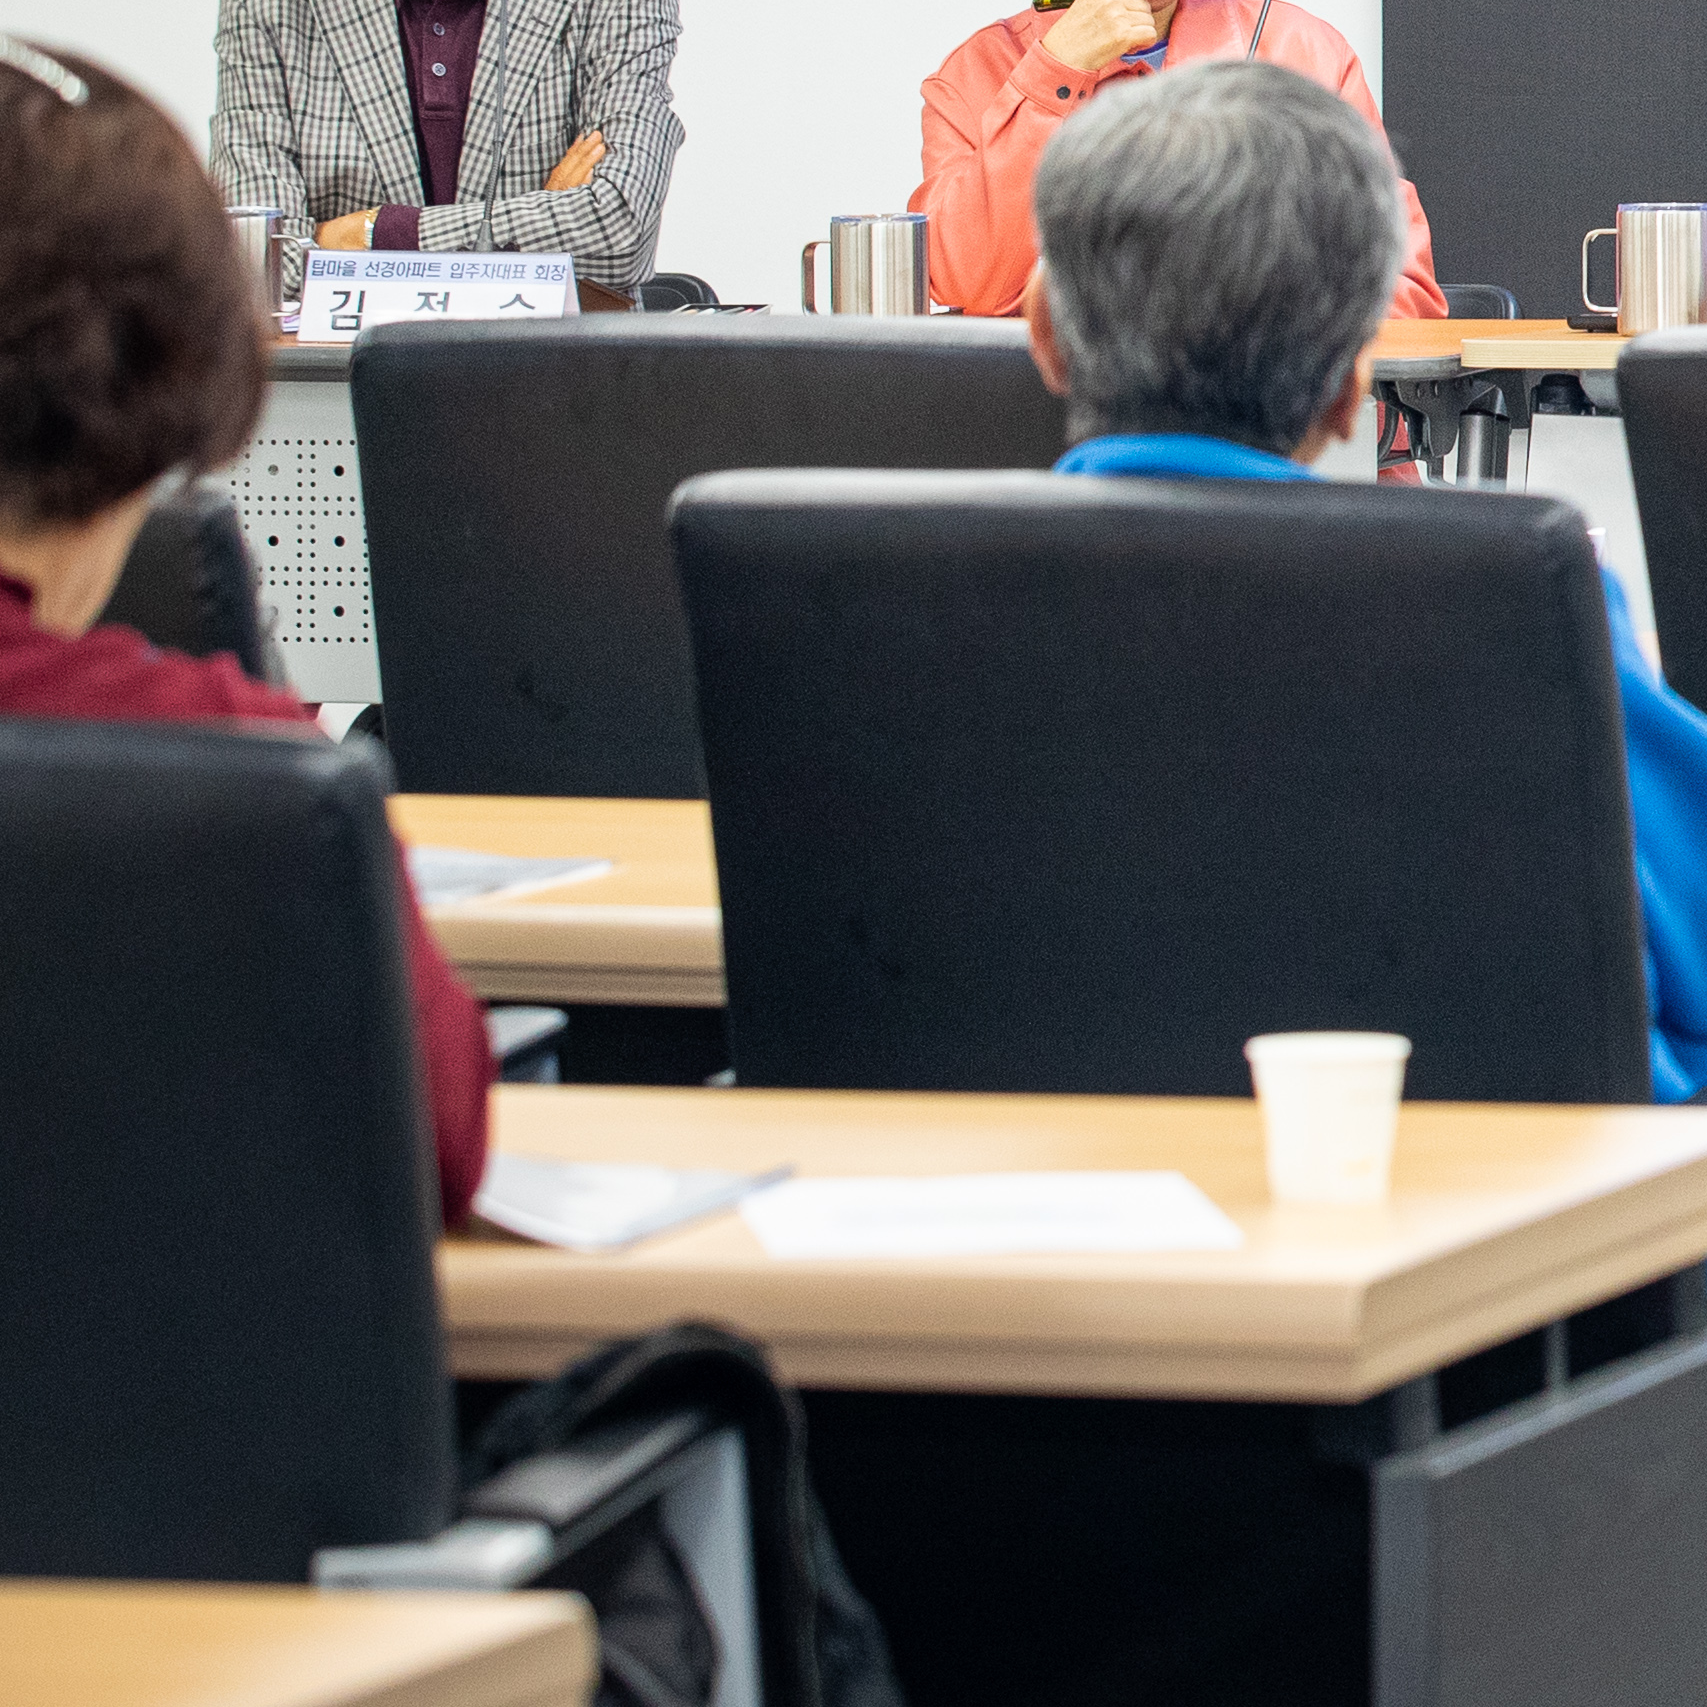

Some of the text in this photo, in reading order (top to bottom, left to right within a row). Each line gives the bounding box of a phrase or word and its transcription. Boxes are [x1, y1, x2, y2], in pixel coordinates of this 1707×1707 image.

[311, 259, 568, 282] 탑마을 선경아파트 입주자대표 회장
